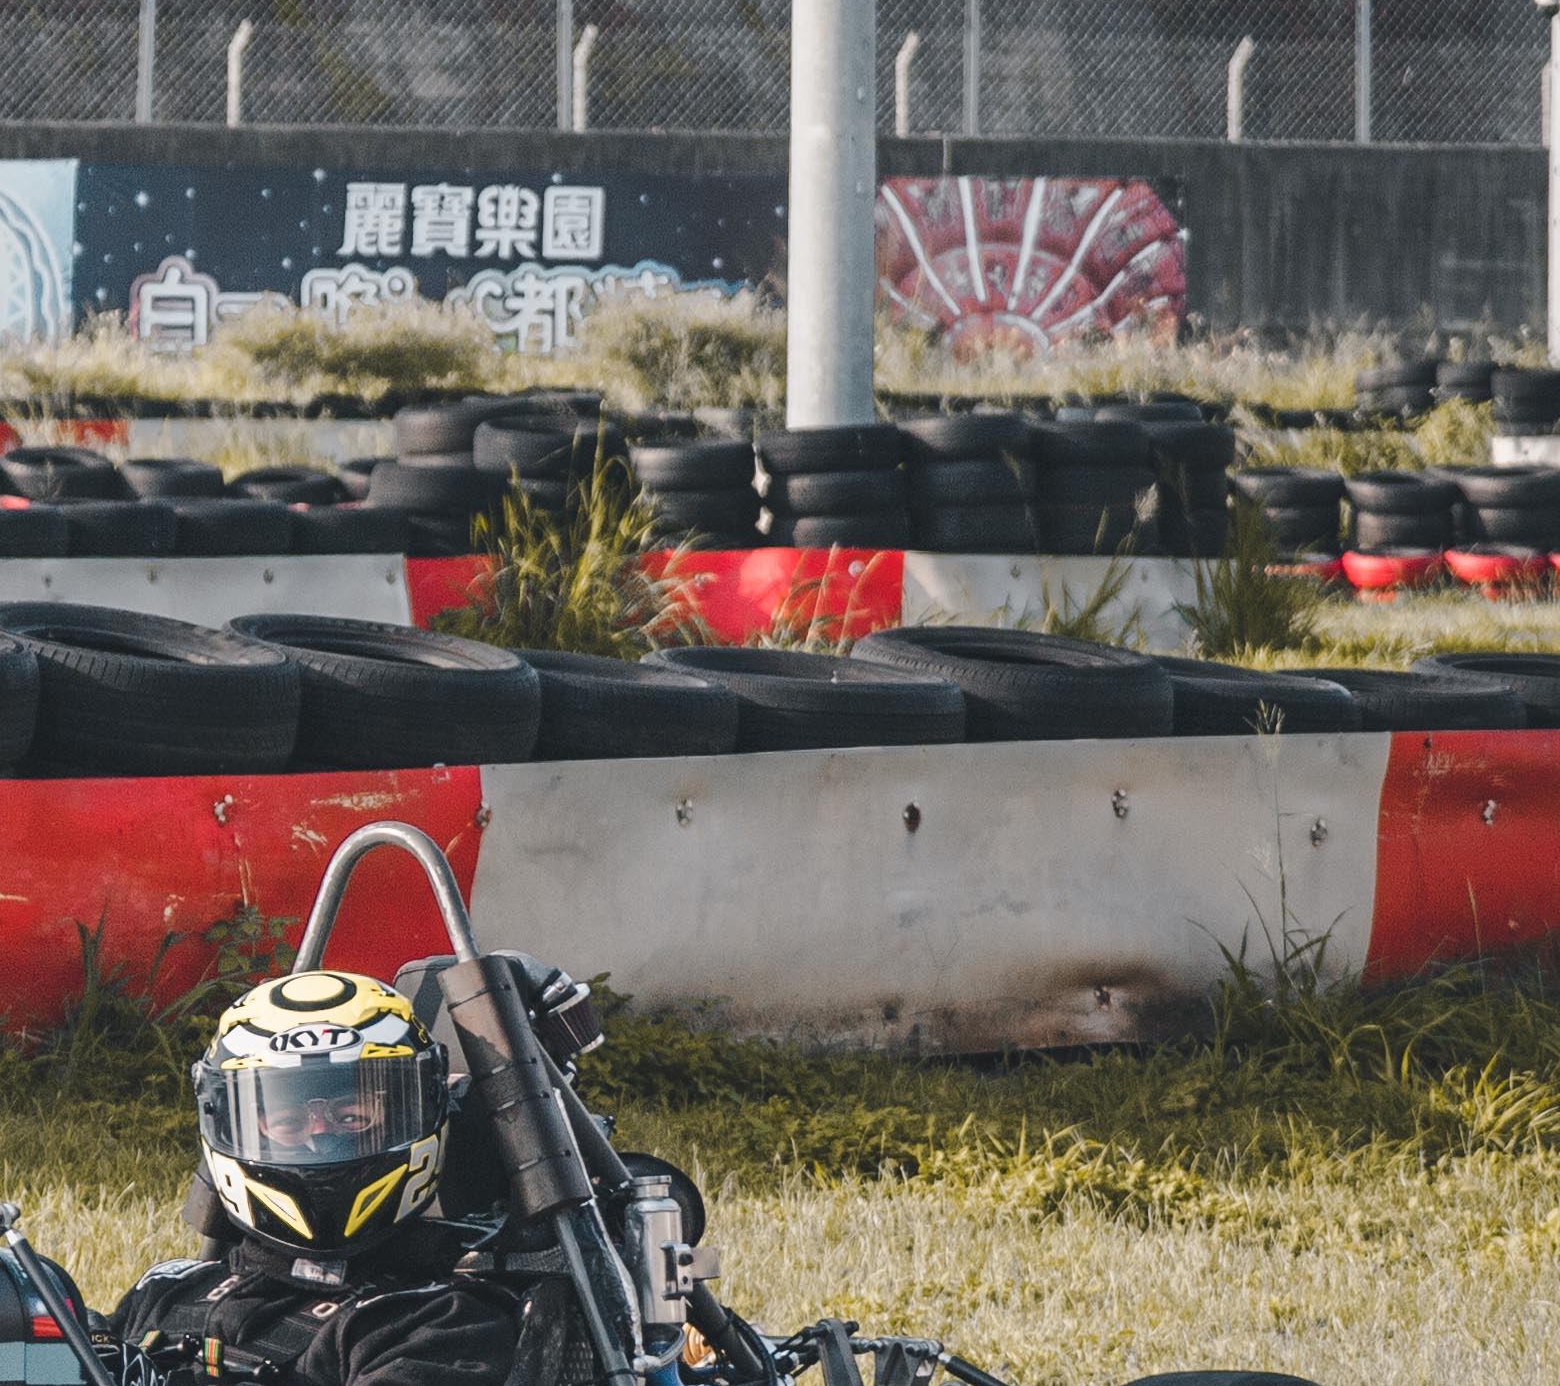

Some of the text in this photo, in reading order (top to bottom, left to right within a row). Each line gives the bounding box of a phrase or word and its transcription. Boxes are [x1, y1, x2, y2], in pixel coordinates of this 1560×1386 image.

[337, 182, 605, 260] 麗寶樂園
[276, 1027, 354, 1050] KYT
